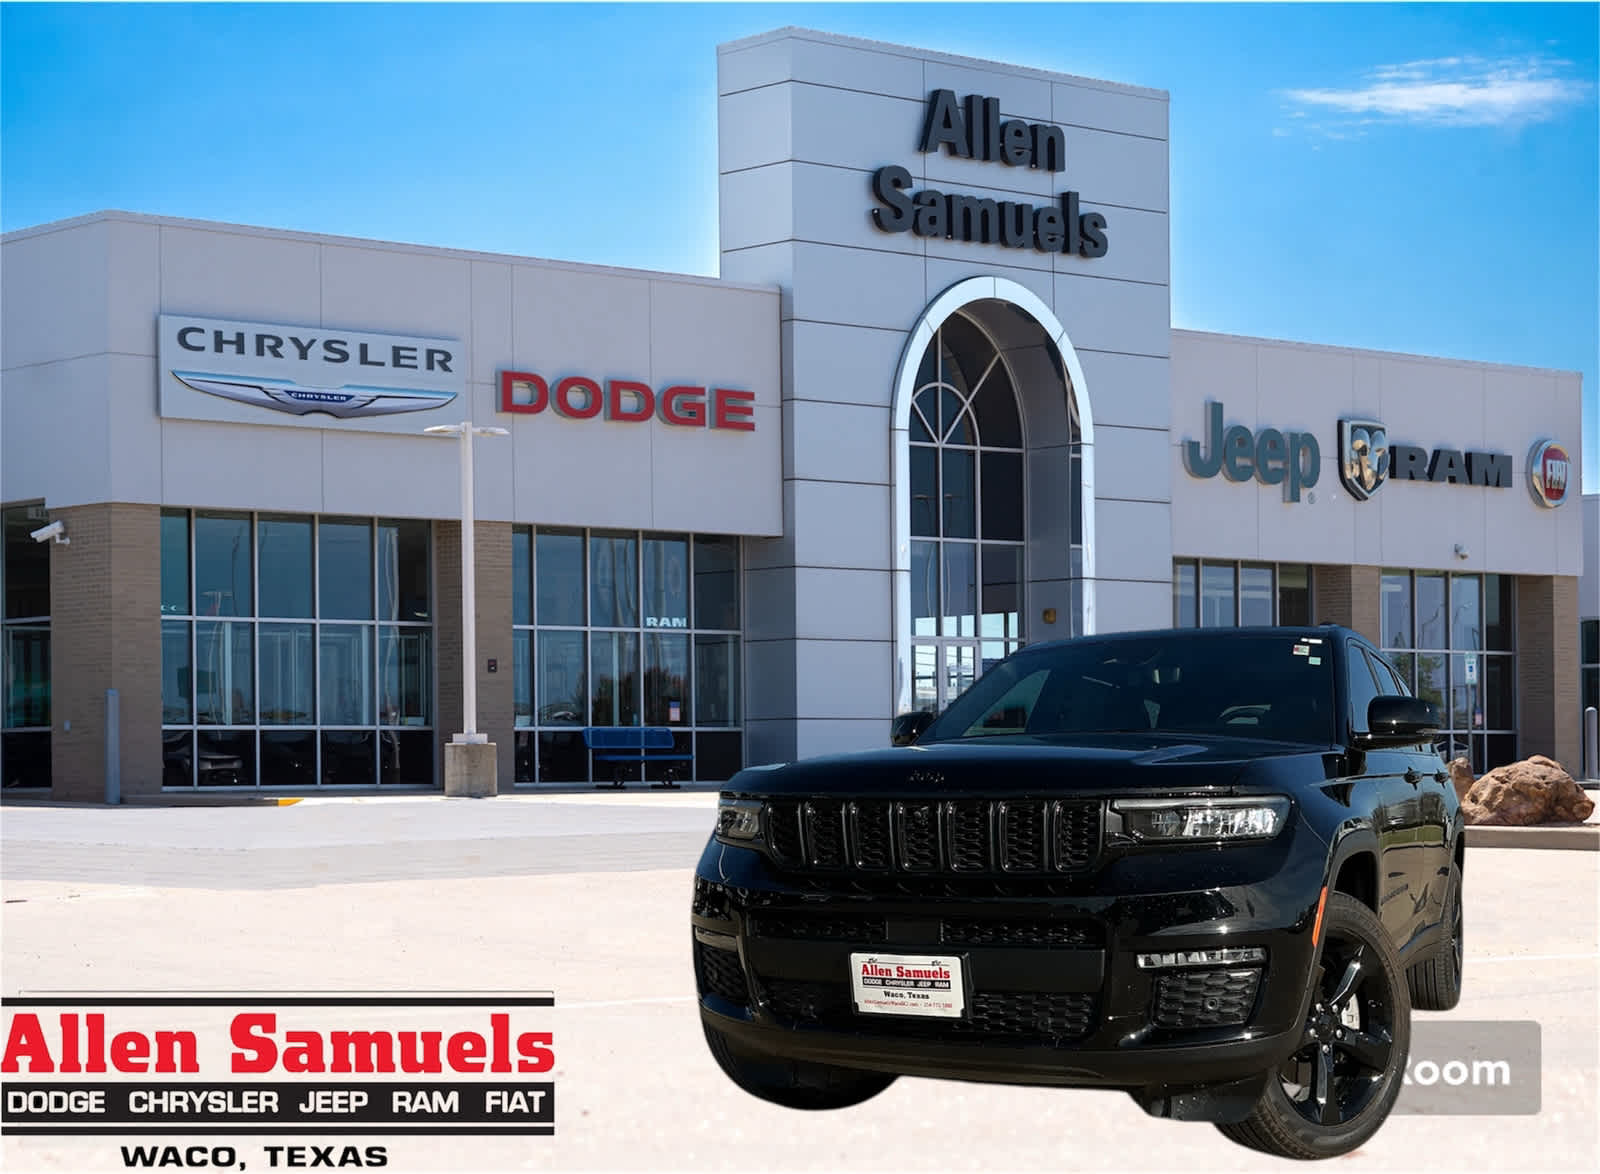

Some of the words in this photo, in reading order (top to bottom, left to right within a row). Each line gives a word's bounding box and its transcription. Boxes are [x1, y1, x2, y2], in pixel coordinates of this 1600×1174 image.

[918, 88, 1066, 172] Allen
[871, 165, 1108, 258] Samuels
[177, 326, 454, 373] CHRYSLER
[291, 392, 346, 401] CHRYSLER
[496, 370, 755, 432] DODGE
[1183, 401, 1321, 503] Jeep
[1389, 444, 1513, 488] RAM
[646, 616, 687, 628] RAM
[861, 963, 893, 977] Allen
[896, 966, 951, 979] Samuels
[907, 991, 930, 1000] Texas
